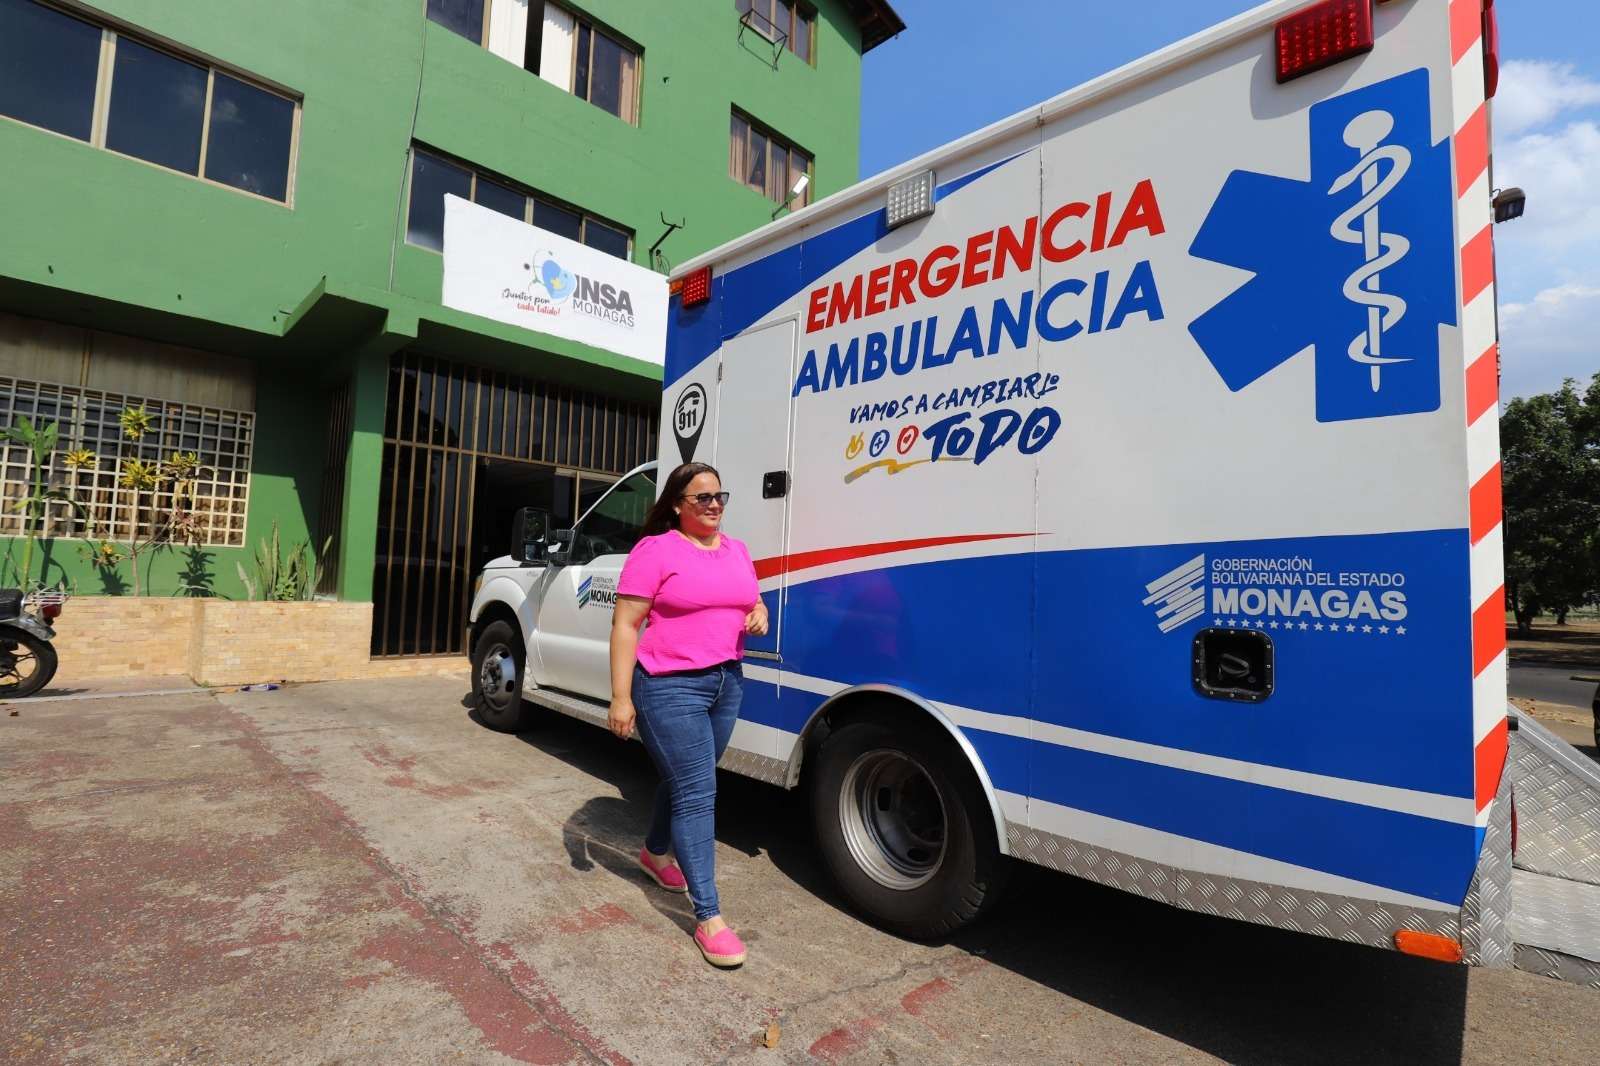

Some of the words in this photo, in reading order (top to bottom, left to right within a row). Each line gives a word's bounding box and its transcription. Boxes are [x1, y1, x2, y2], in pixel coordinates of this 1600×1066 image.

[805, 178, 1166, 334] EMERGENCIA
[573, 274, 634, 316] INSA
[572, 299, 636, 328] MONAGAS
[791, 260, 1165, 398] AMBULANCIA
[678, 407, 697, 431] 911
[849, 394, 914, 424] VAMOS
[915, 393, 928, 415] A
[1211, 556, 1313, 571] GOBERNACIÓN
[1211, 572, 1303, 586] BOLIVARIANA
[1305, 572, 1334, 587] DEL
[1338, 572, 1405, 587] ESTADO
[590, 589, 617, 605] MONAG
[1211, 587, 1409, 621] MONAGAS
